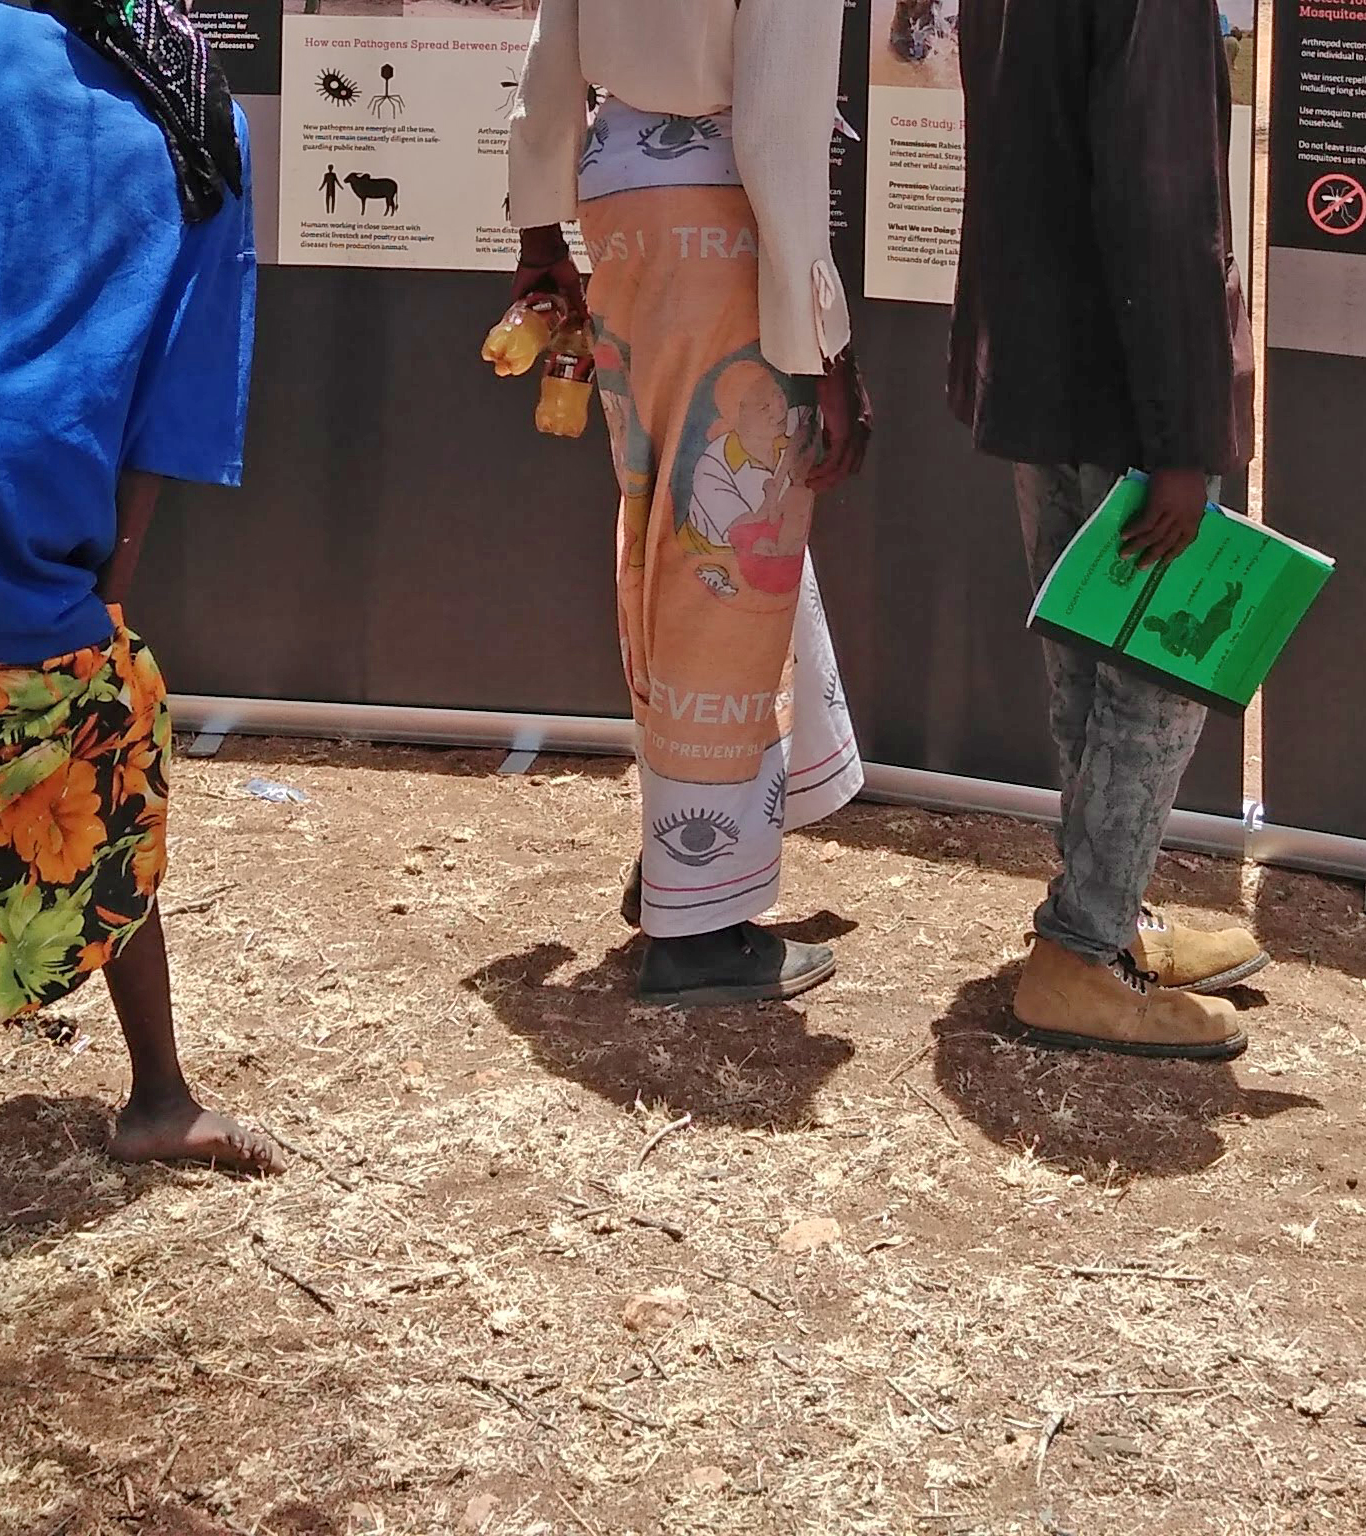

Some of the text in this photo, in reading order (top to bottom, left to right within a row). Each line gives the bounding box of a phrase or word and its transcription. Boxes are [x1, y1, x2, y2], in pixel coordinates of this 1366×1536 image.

[305, 37, 329, 46] How
[353, 38, 407, 50] Pathogens
[410, 39, 449, 51] Spread
[452, 40, 497, 50] Between
[890, 116, 956, 131] Case Study:
[671, 227, 758, 258] TRA
